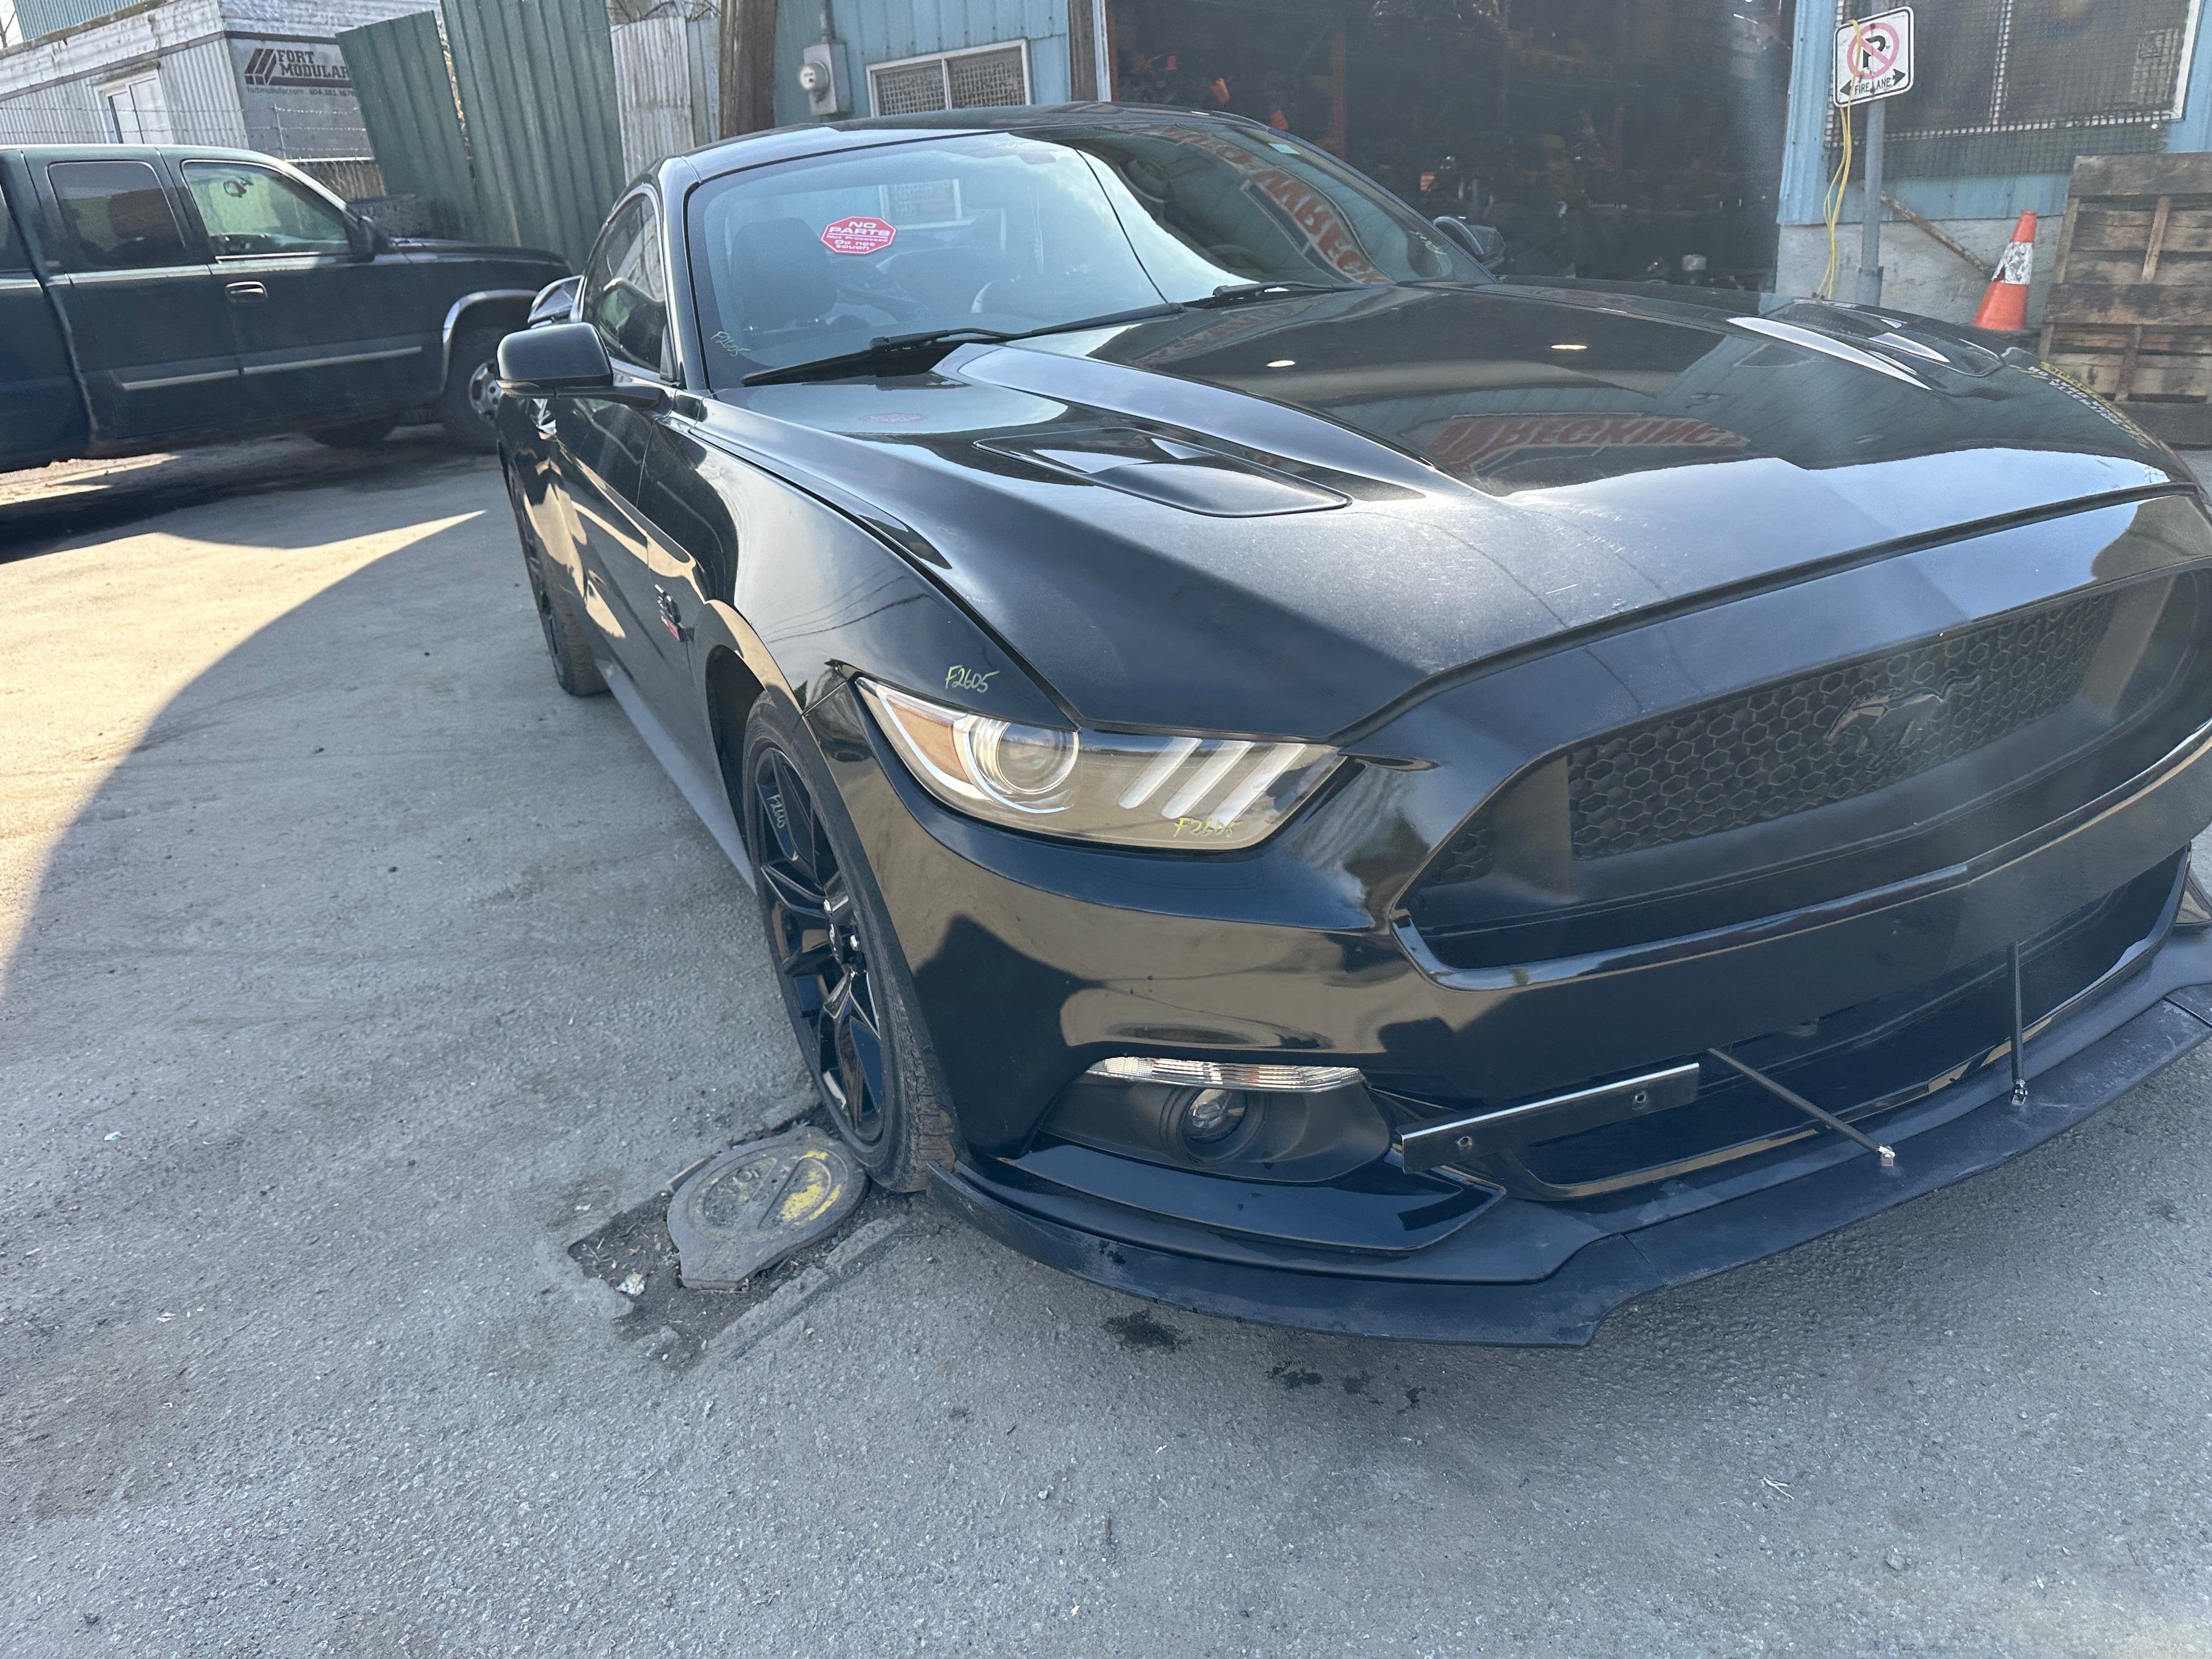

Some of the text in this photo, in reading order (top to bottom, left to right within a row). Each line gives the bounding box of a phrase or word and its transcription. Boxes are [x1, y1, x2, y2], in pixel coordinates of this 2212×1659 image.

[275, 50, 314, 64] FORT
[1855, 77, 1891, 95] FIRE LANE
[829, 227, 890, 236] PARTS
[945, 664, 1000, 693] F2605
[1173, 817, 1244, 838] F2605
